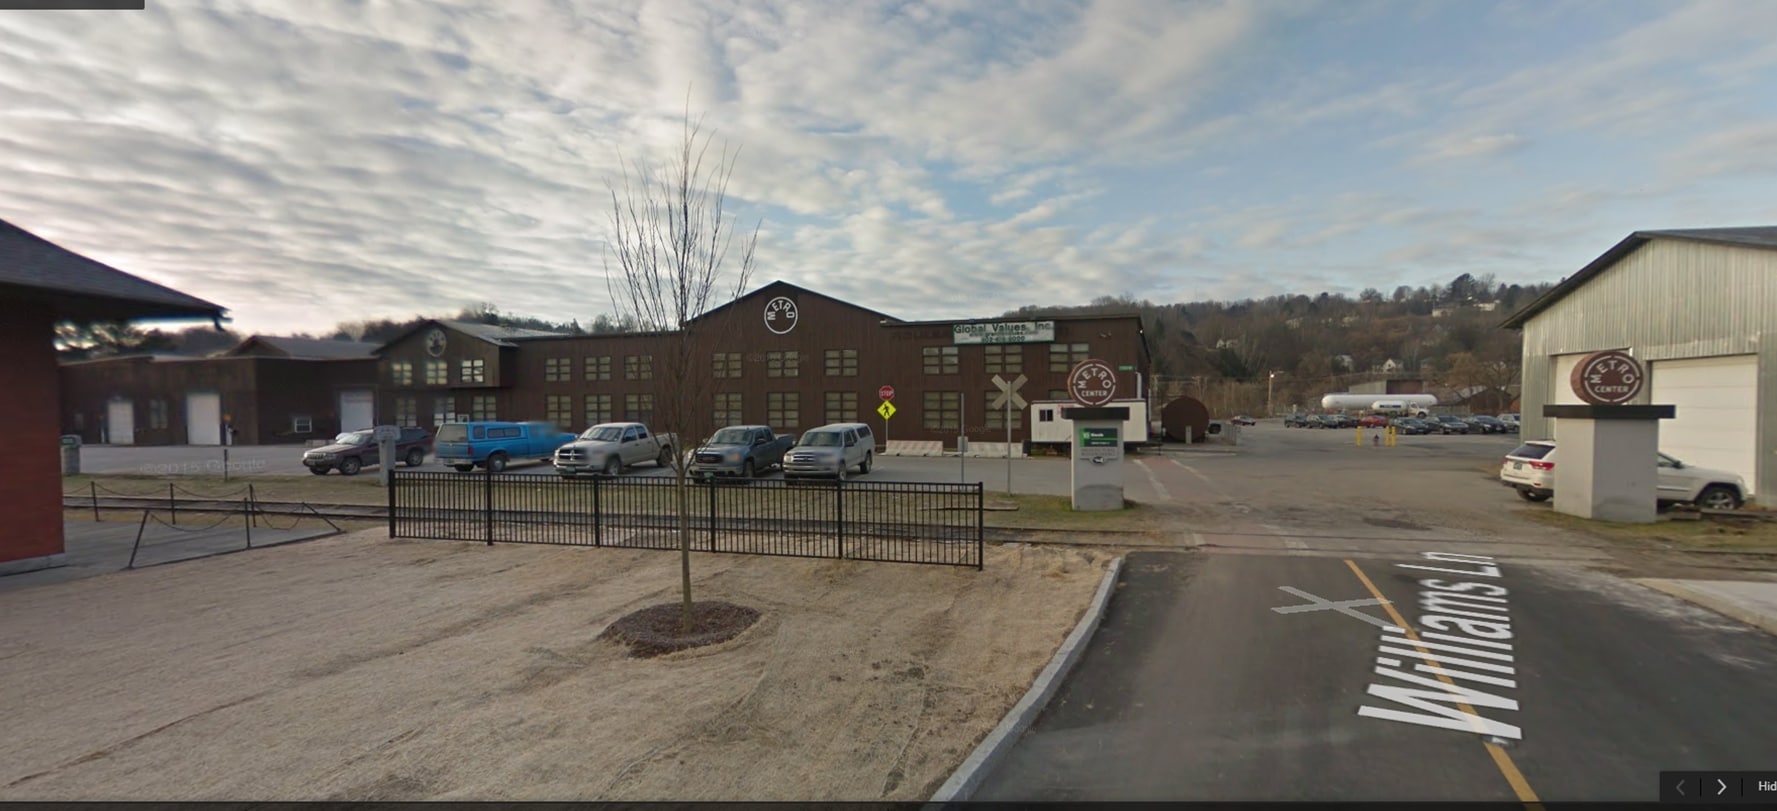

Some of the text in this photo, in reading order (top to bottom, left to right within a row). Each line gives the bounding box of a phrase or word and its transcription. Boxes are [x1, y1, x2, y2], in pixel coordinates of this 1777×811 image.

[767, 300, 795, 320] METRO
[954, 324, 986, 333] Global
[1078, 368, 1112, 388] METRO
[1590, 360, 1635, 384] METRO
